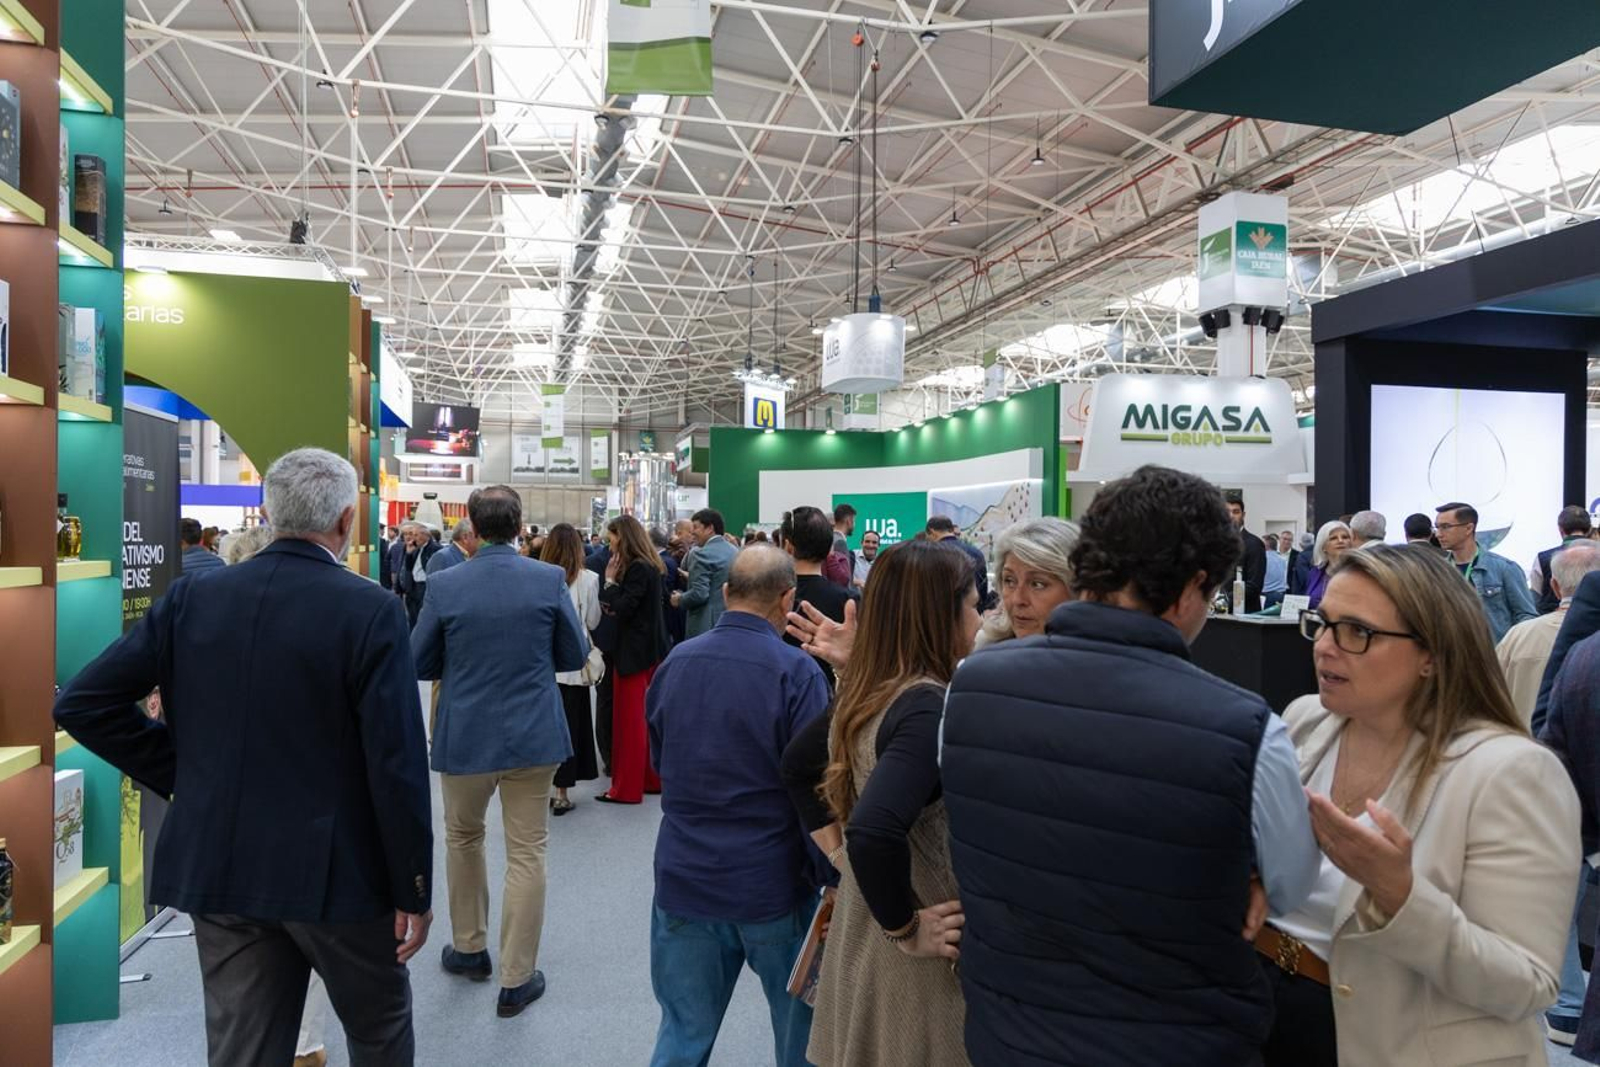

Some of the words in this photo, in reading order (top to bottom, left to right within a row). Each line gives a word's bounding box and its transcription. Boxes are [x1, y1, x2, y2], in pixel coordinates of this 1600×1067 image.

[124, 304, 184, 325] arias
[1121, 402, 1271, 433] MIGASA
[1171, 432, 1223, 446] GRUPO
[123, 521, 143, 542] DEL
